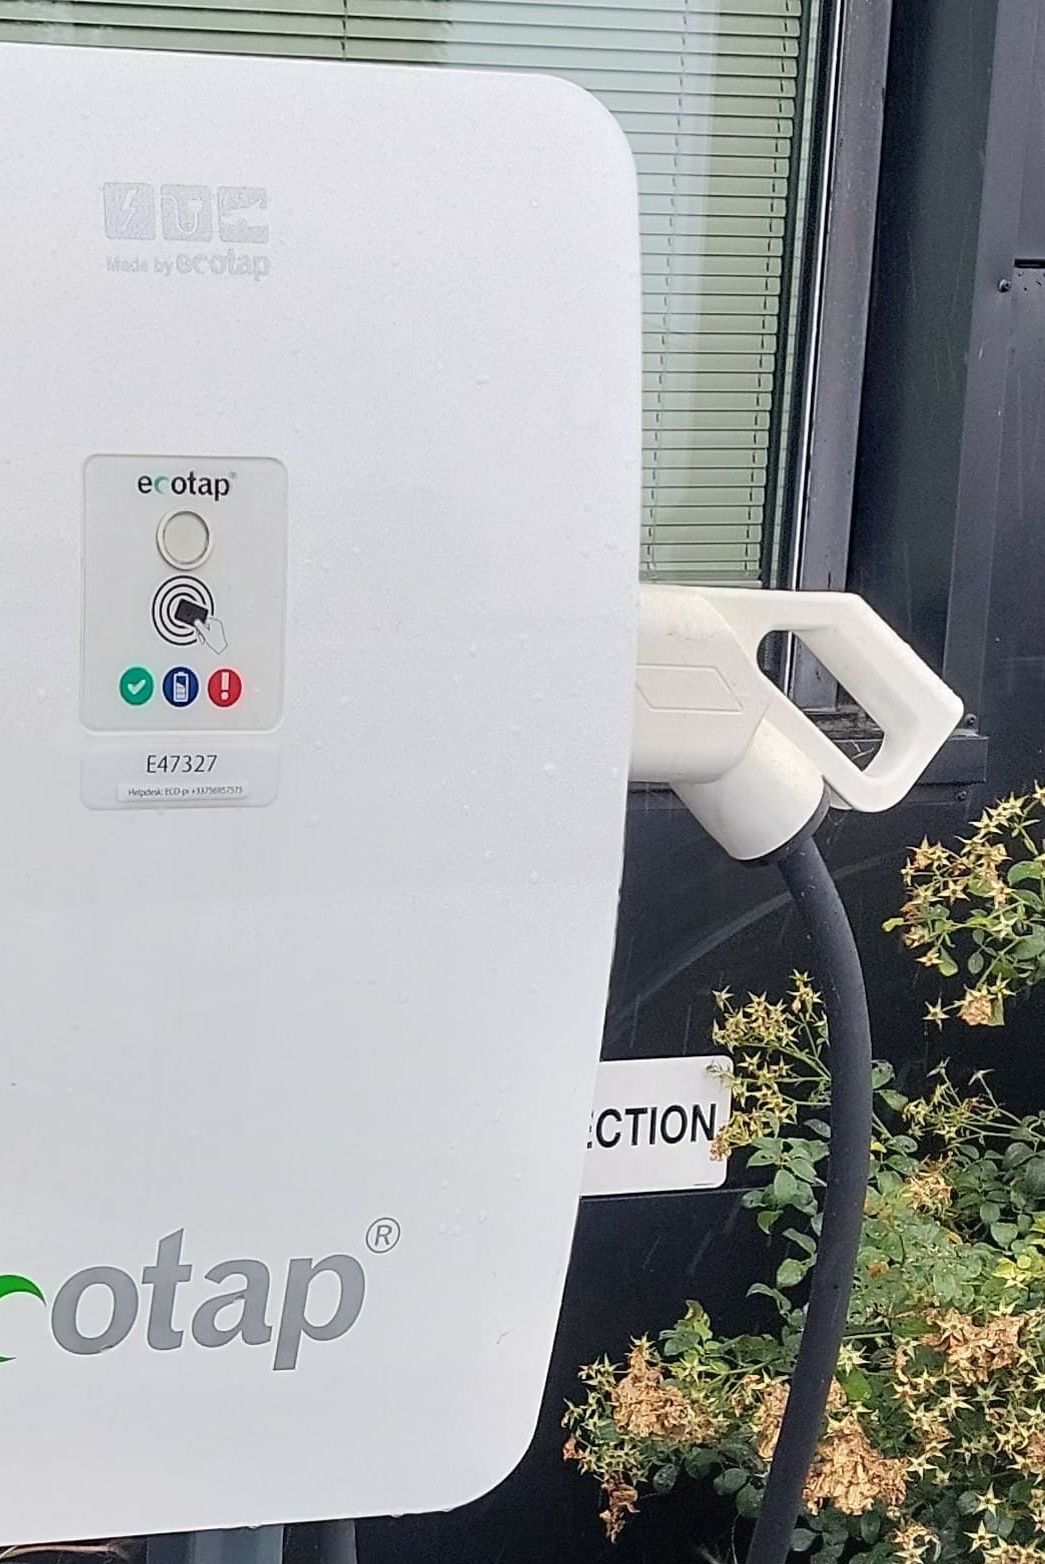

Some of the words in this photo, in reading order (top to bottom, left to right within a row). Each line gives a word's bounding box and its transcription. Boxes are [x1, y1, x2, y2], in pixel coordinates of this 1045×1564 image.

[106, 255, 148, 273] Made
[154, 254, 174, 276] by
[175, 248, 271, 281] ecotap
[146, 754, 218, 774] E47327
[587, 1103, 717, 1149] CTION
